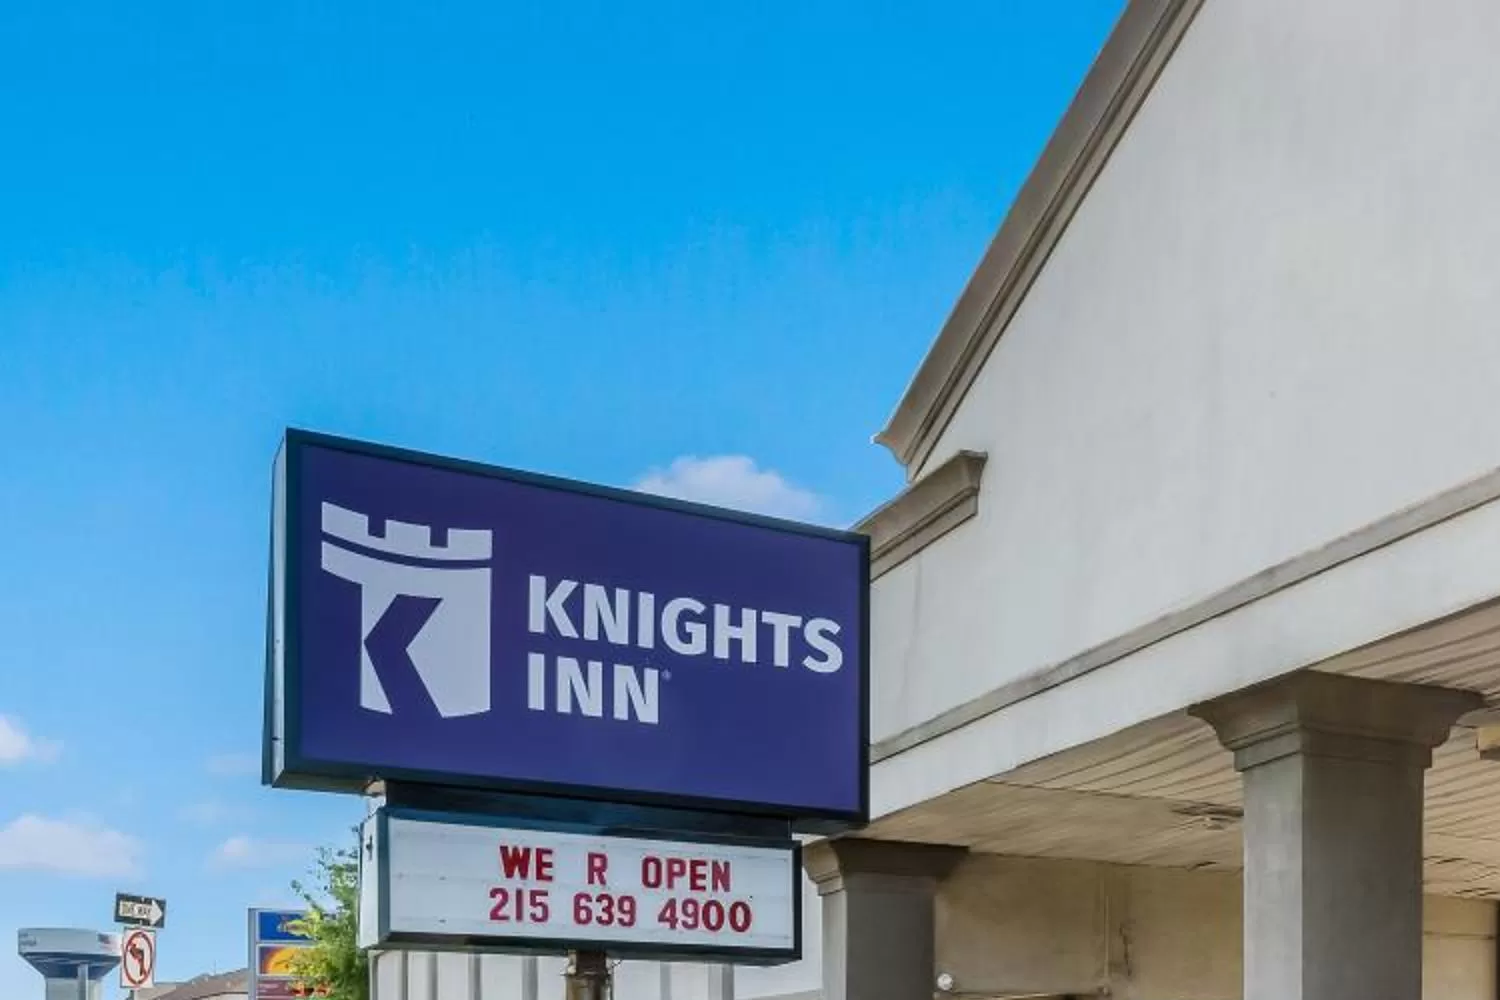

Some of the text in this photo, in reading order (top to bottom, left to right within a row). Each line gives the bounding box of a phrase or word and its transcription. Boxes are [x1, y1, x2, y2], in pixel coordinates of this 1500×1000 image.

[528, 575, 843, 674] KNIGHTS
[528, 652, 660, 725] INN
[500, 846, 731, 892] WE R OPEN
[489, 887, 753, 933] 215 639 4900
